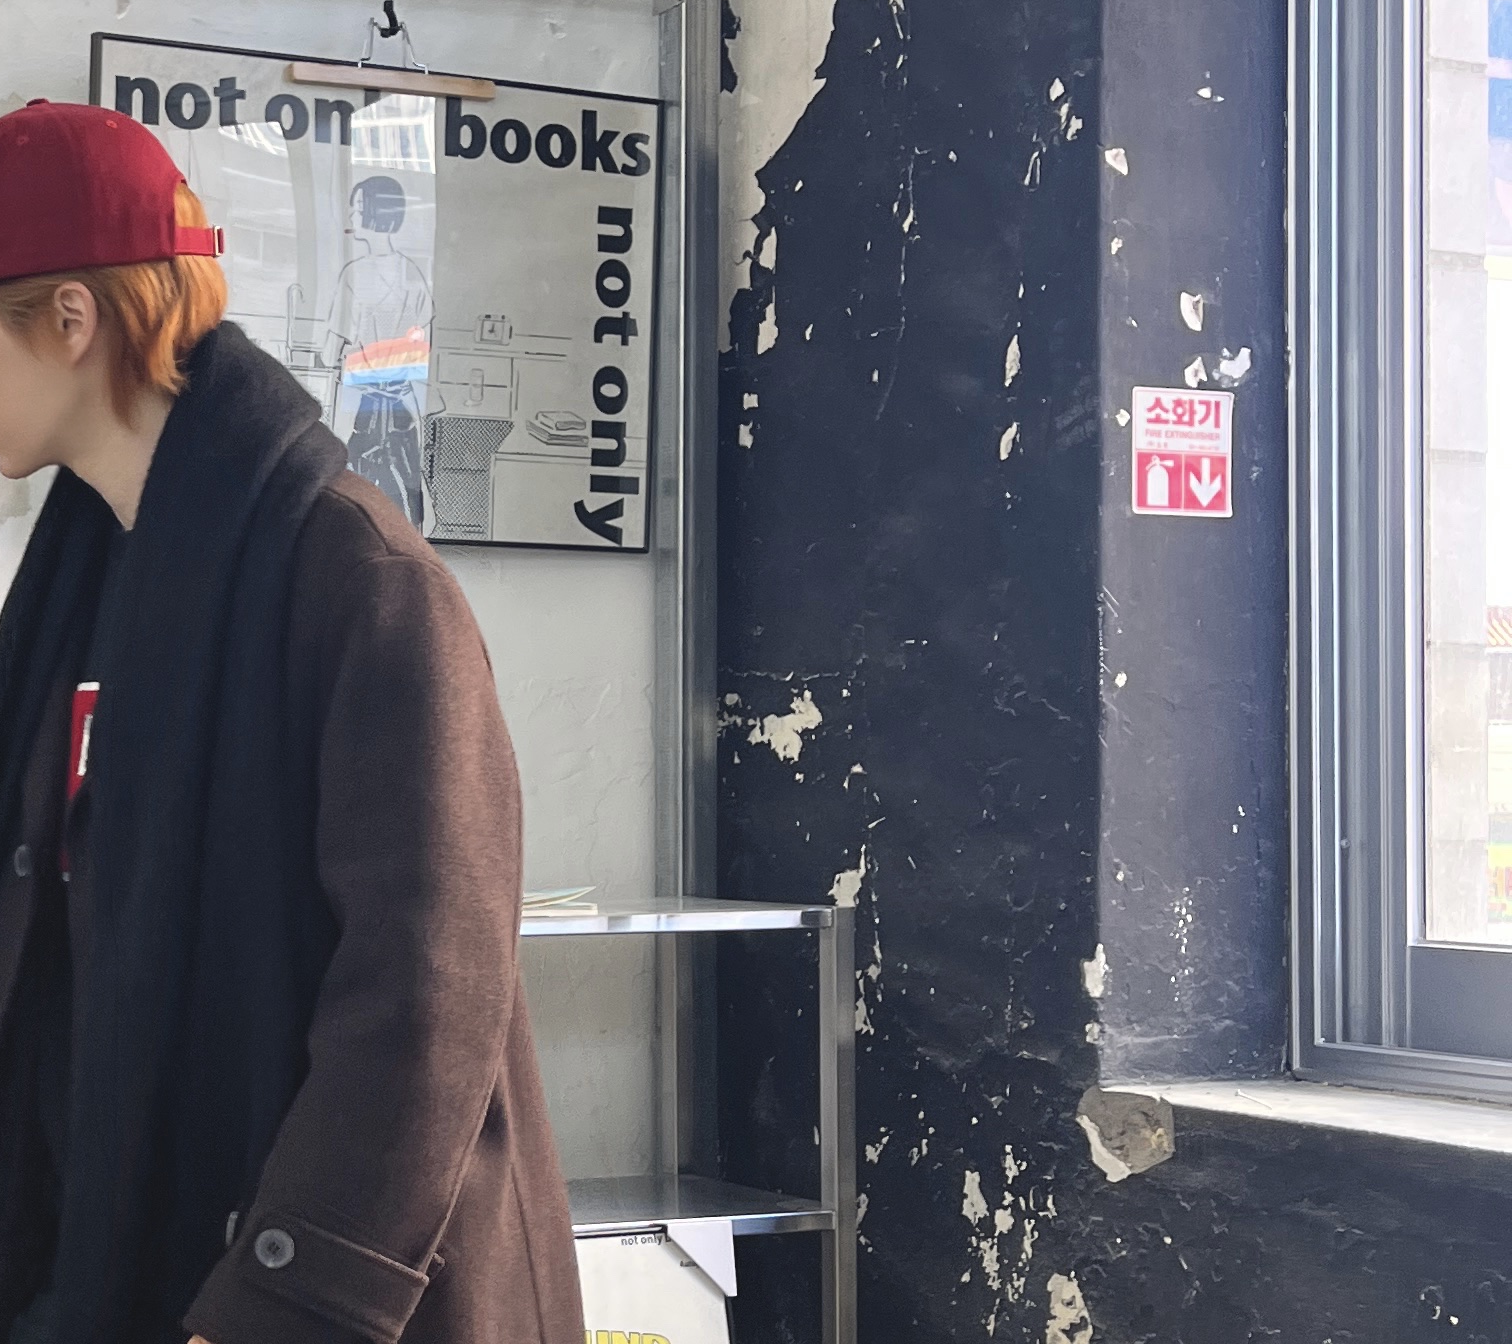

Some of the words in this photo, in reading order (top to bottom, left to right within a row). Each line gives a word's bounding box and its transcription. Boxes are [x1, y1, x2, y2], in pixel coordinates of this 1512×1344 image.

[115, 75, 246, 130] not
[445, 97, 652, 177] books
[595, 205, 638, 346] not
[1145, 429, 1162, 439] FIRE
[1146, 396, 1221, 429] 소화기
[574, 366, 640, 545] only
[621, 1235, 638, 1245] not
[641, 1233, 663, 1245] only
